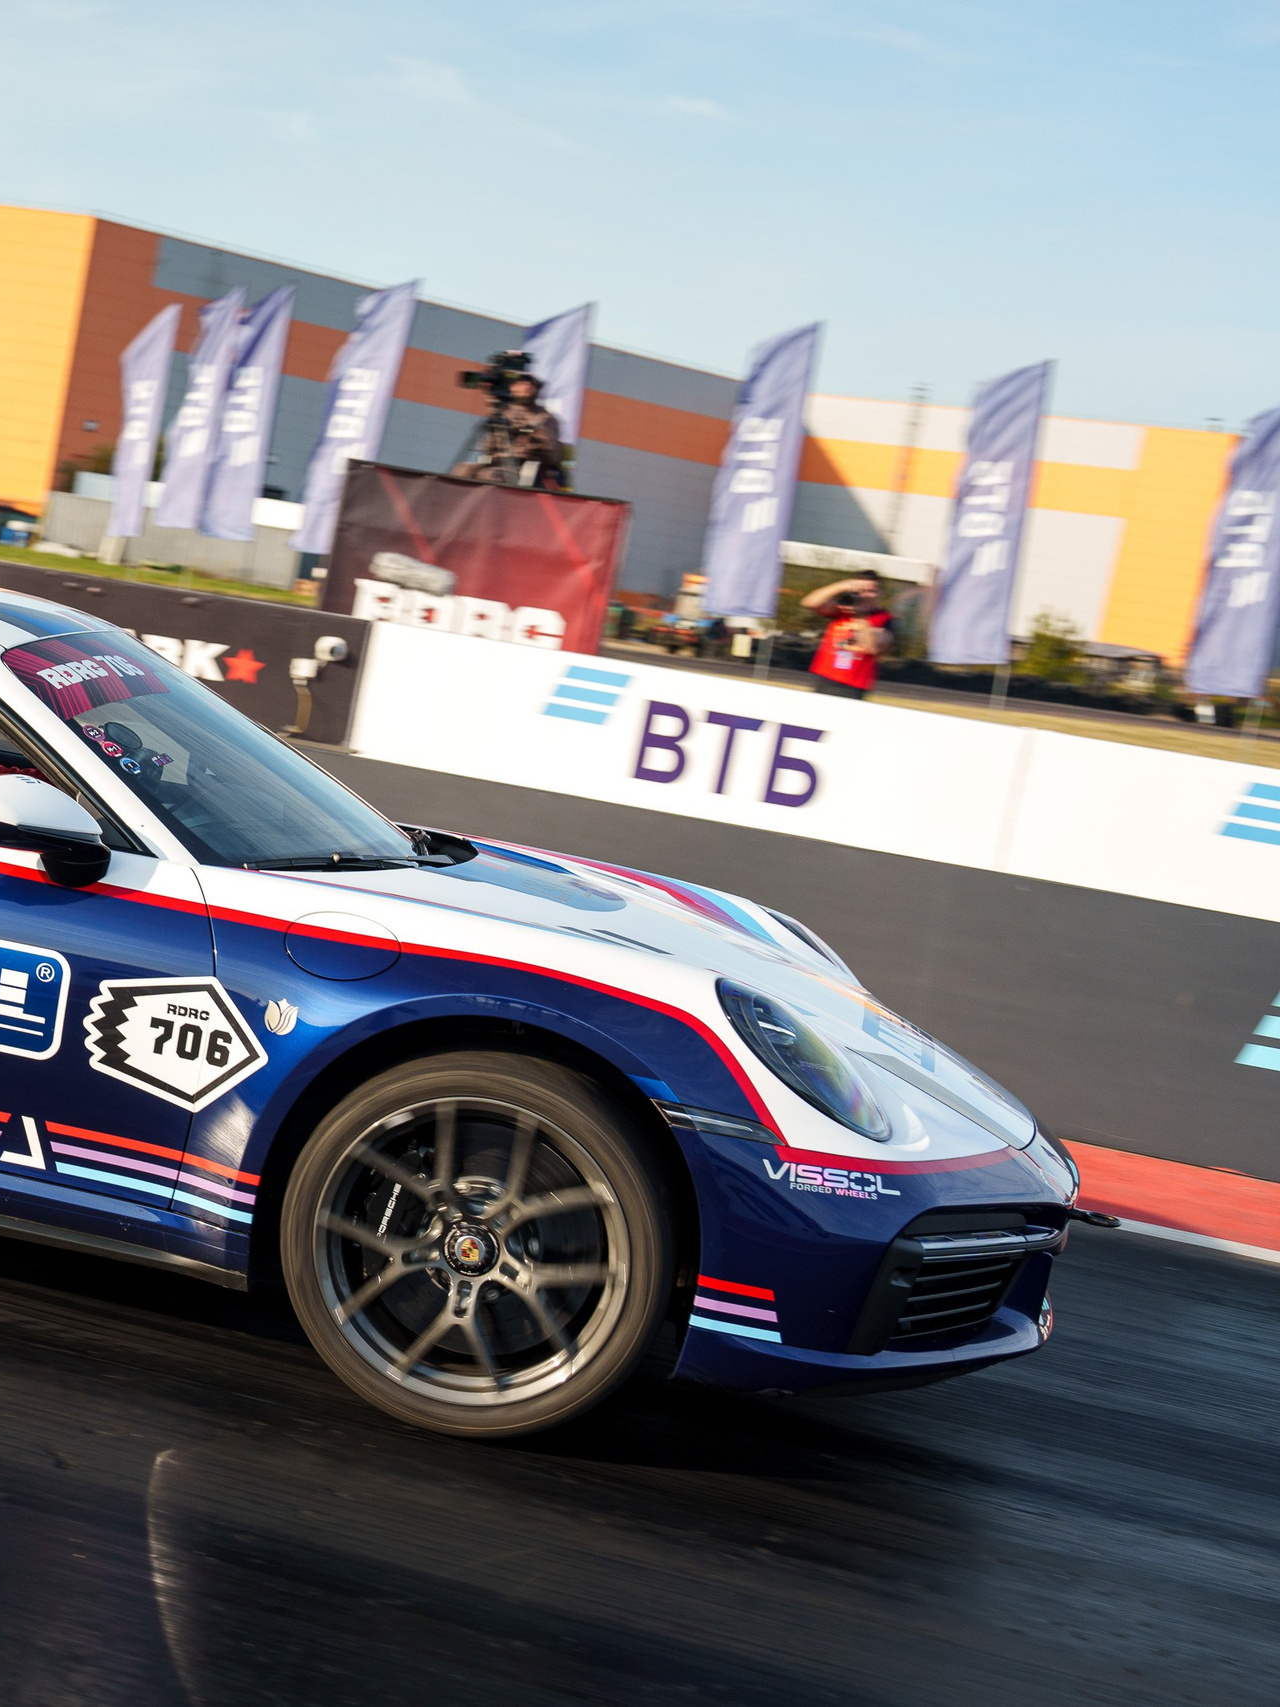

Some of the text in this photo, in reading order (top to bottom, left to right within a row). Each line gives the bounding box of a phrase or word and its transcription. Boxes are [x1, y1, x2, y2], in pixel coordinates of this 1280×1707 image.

[36, 655, 145, 690] RDRC 706
[632, 699, 829, 808] ВТБ
[167, 1003, 210, 1021] RDRC
[150, 1016, 233, 1068] 706
[762, 1158, 901, 1196] VISSOL
[789, 1182, 878, 1200] FORGED WHEELS
